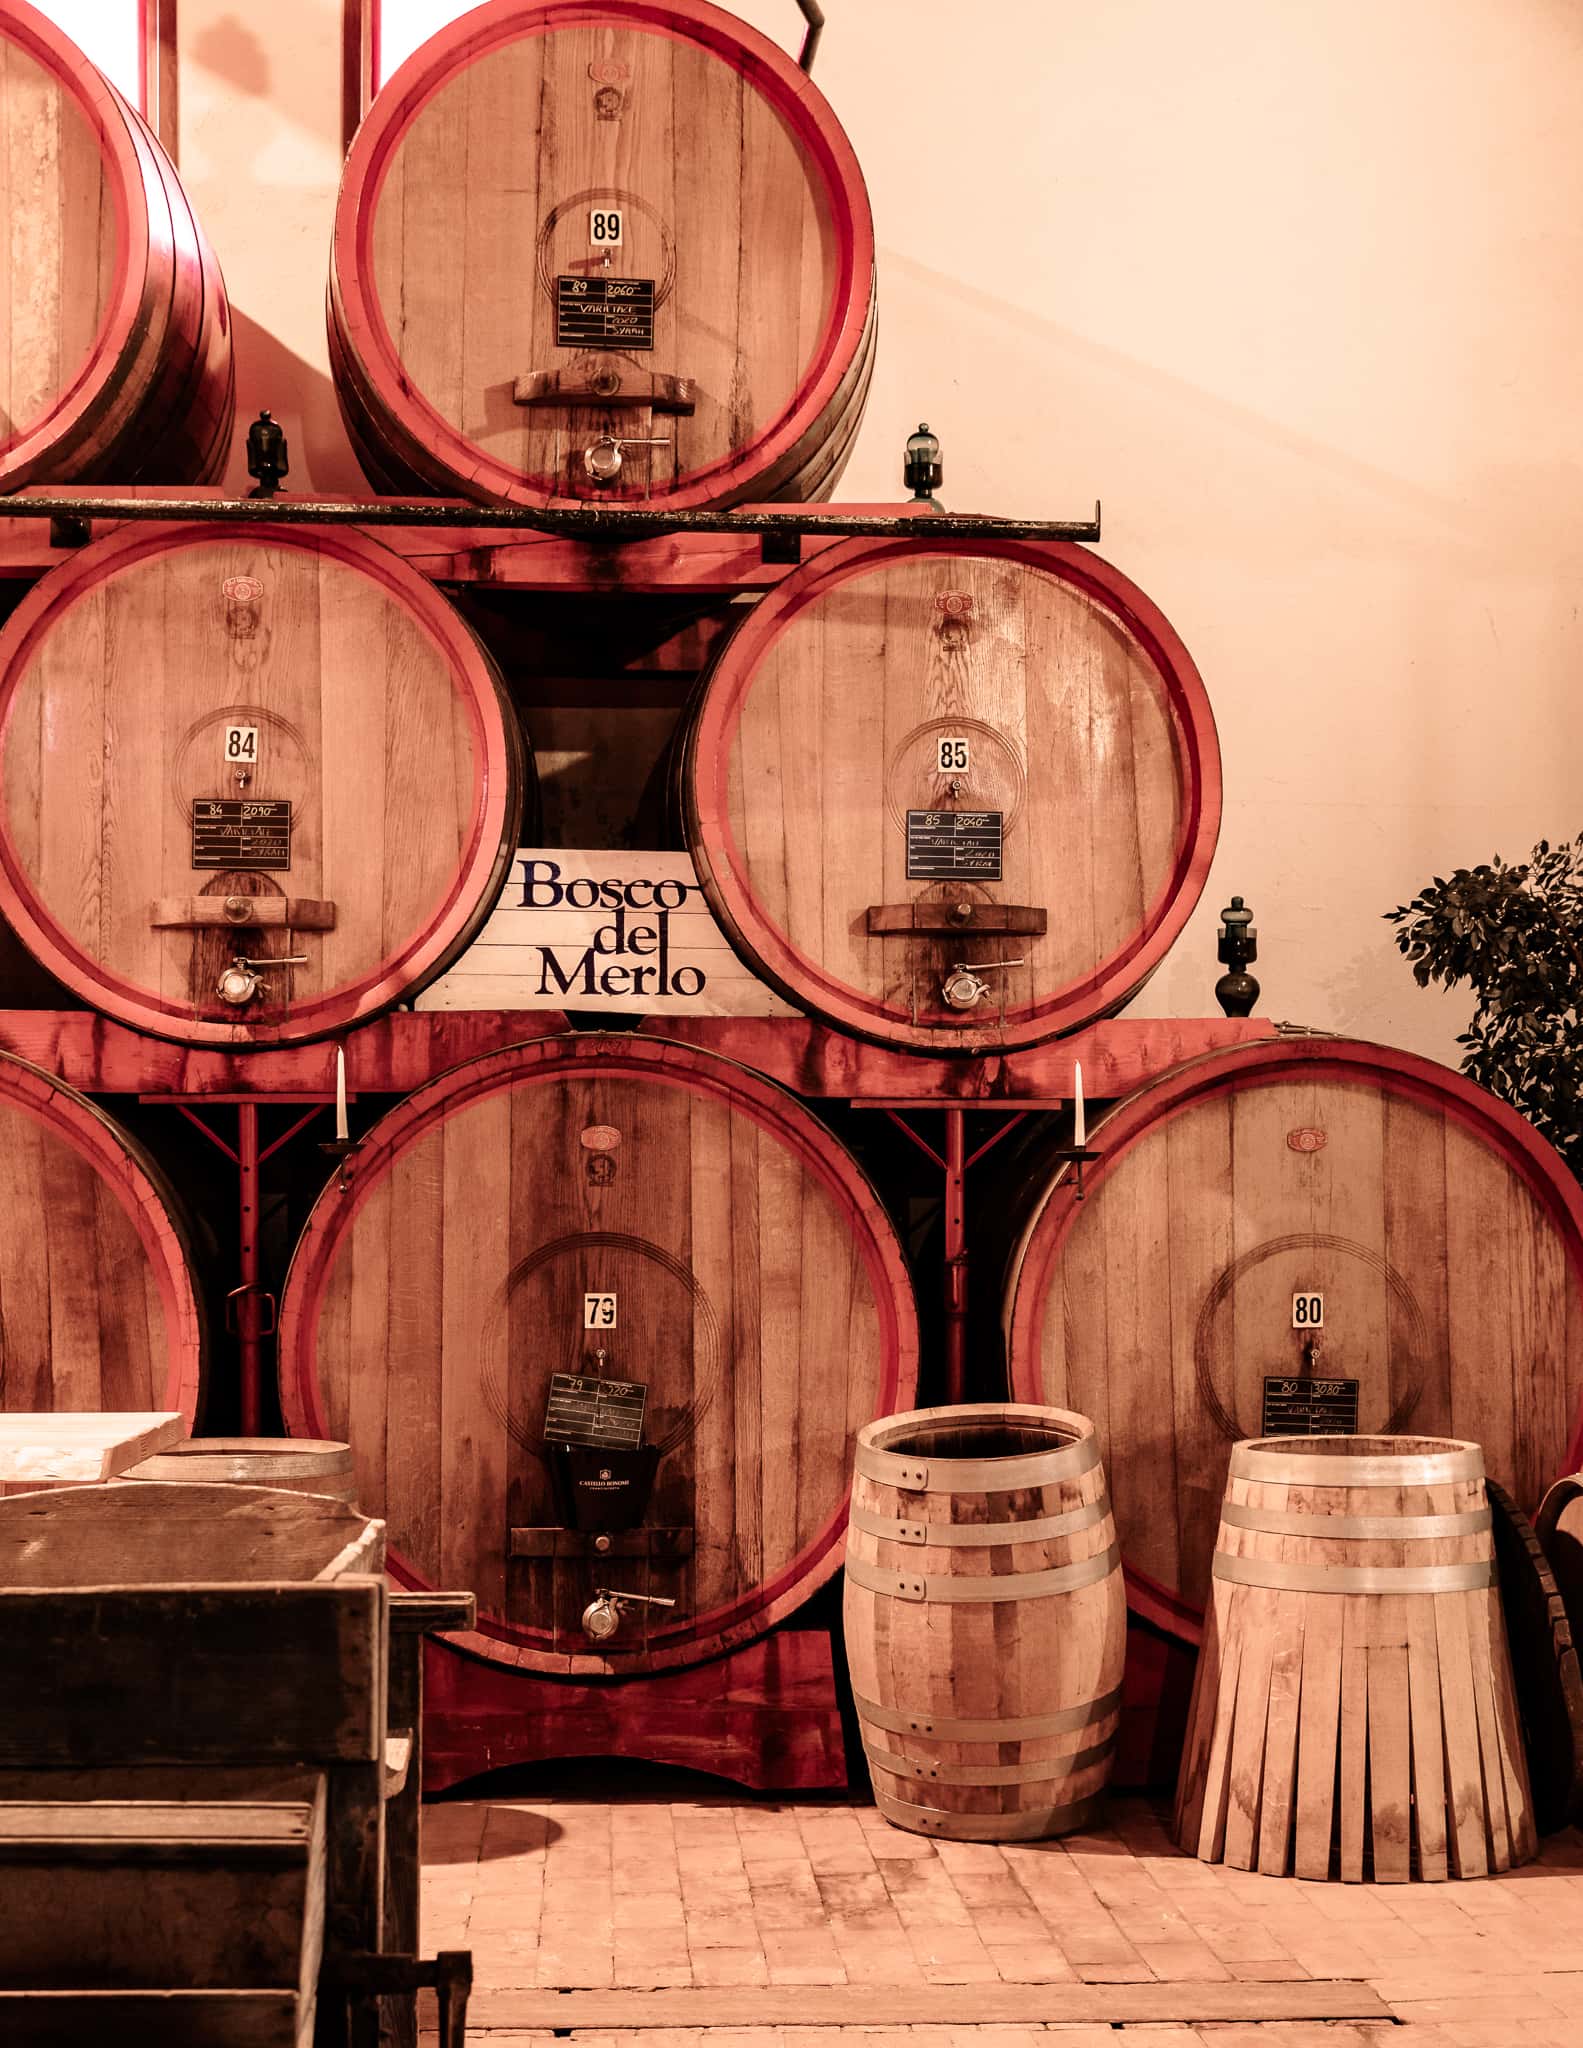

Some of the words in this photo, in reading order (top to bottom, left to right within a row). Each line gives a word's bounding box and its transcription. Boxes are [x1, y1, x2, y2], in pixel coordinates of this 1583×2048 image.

[593, 213, 620, 241] 89
[572, 280, 588, 293] 89
[607, 285, 634, 296] 2060
[228, 730, 255, 759] 84
[941, 741, 967, 769] 85
[209, 804, 223, 816] 84
[924, 814, 941, 826] 85
[516, 860, 688, 910] Bosco
[593, 906, 670, 960] del
[535, 942, 706, 996] Merlo
[587, 1297, 615, 1325] 79
[1295, 1296, 1322, 1324] 80
[1281, 1381, 1298, 1394] 80
